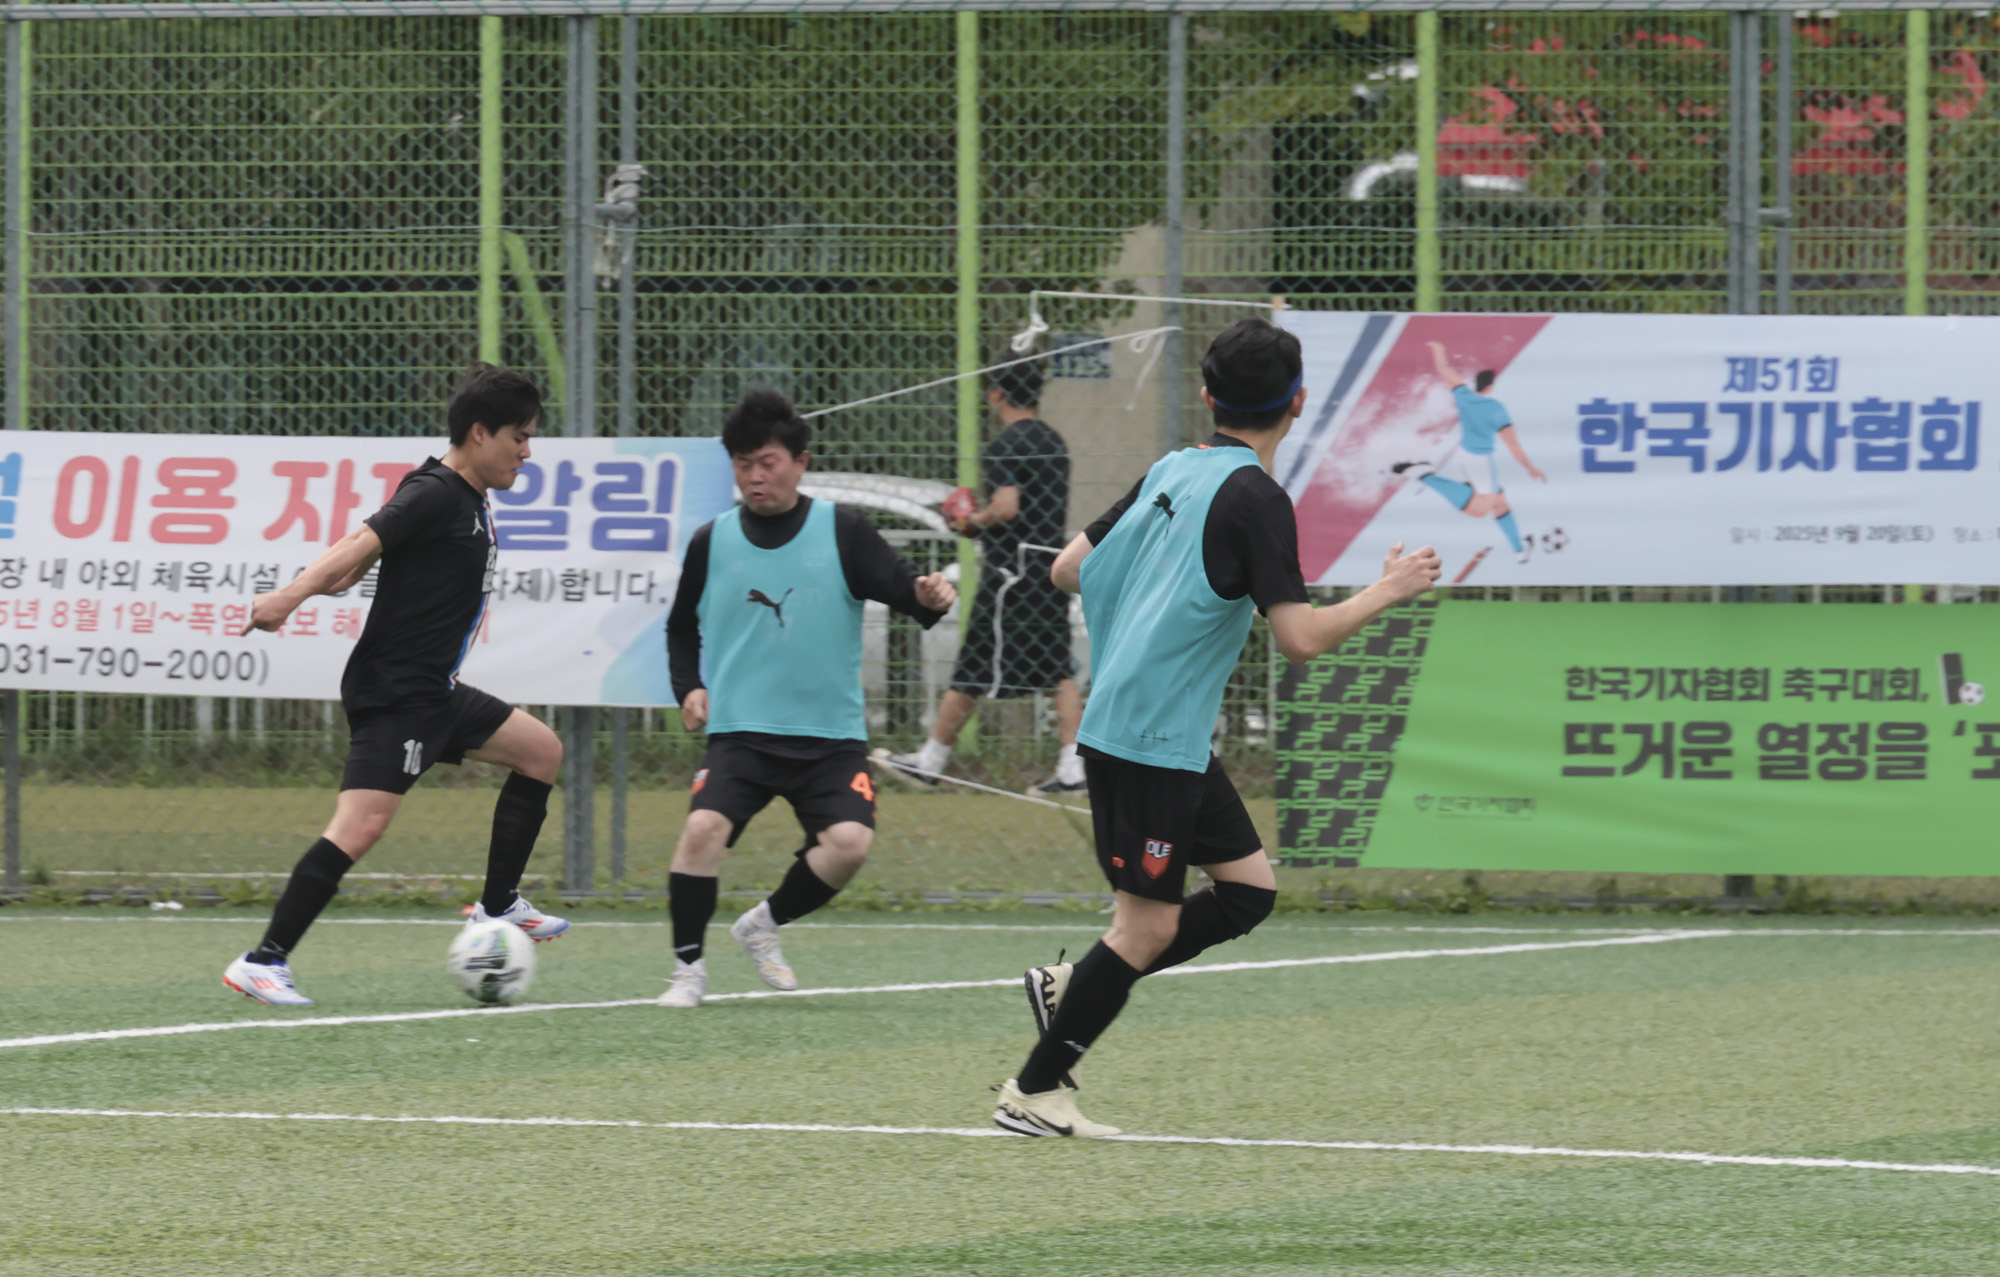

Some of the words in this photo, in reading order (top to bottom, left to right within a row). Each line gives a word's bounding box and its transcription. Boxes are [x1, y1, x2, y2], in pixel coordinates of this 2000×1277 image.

[1722, 355, 1840, 393] 제51회
[1578, 397, 1982, 473] 한국기자협회
[52, 454, 238, 545] 이용
[493, 458, 676, 552] 알림
[1774, 525, 1829, 543] 2025년
[1833, 525, 1860, 543] 9월
[39, 557, 68, 590] 내
[78, 559, 141, 591] 야외
[150, 561, 281, 595] 체육시설
[50, 598, 101, 632] 8월
[112, 601, 319, 639] 1일~폭염보
[1565, 666, 1770, 701] 한국기자협회
[1783, 666, 1929, 702] 축구대회,
[1562, 721, 1733, 779] 뜨거운
[1757, 722, 1929, 781] 열정을
